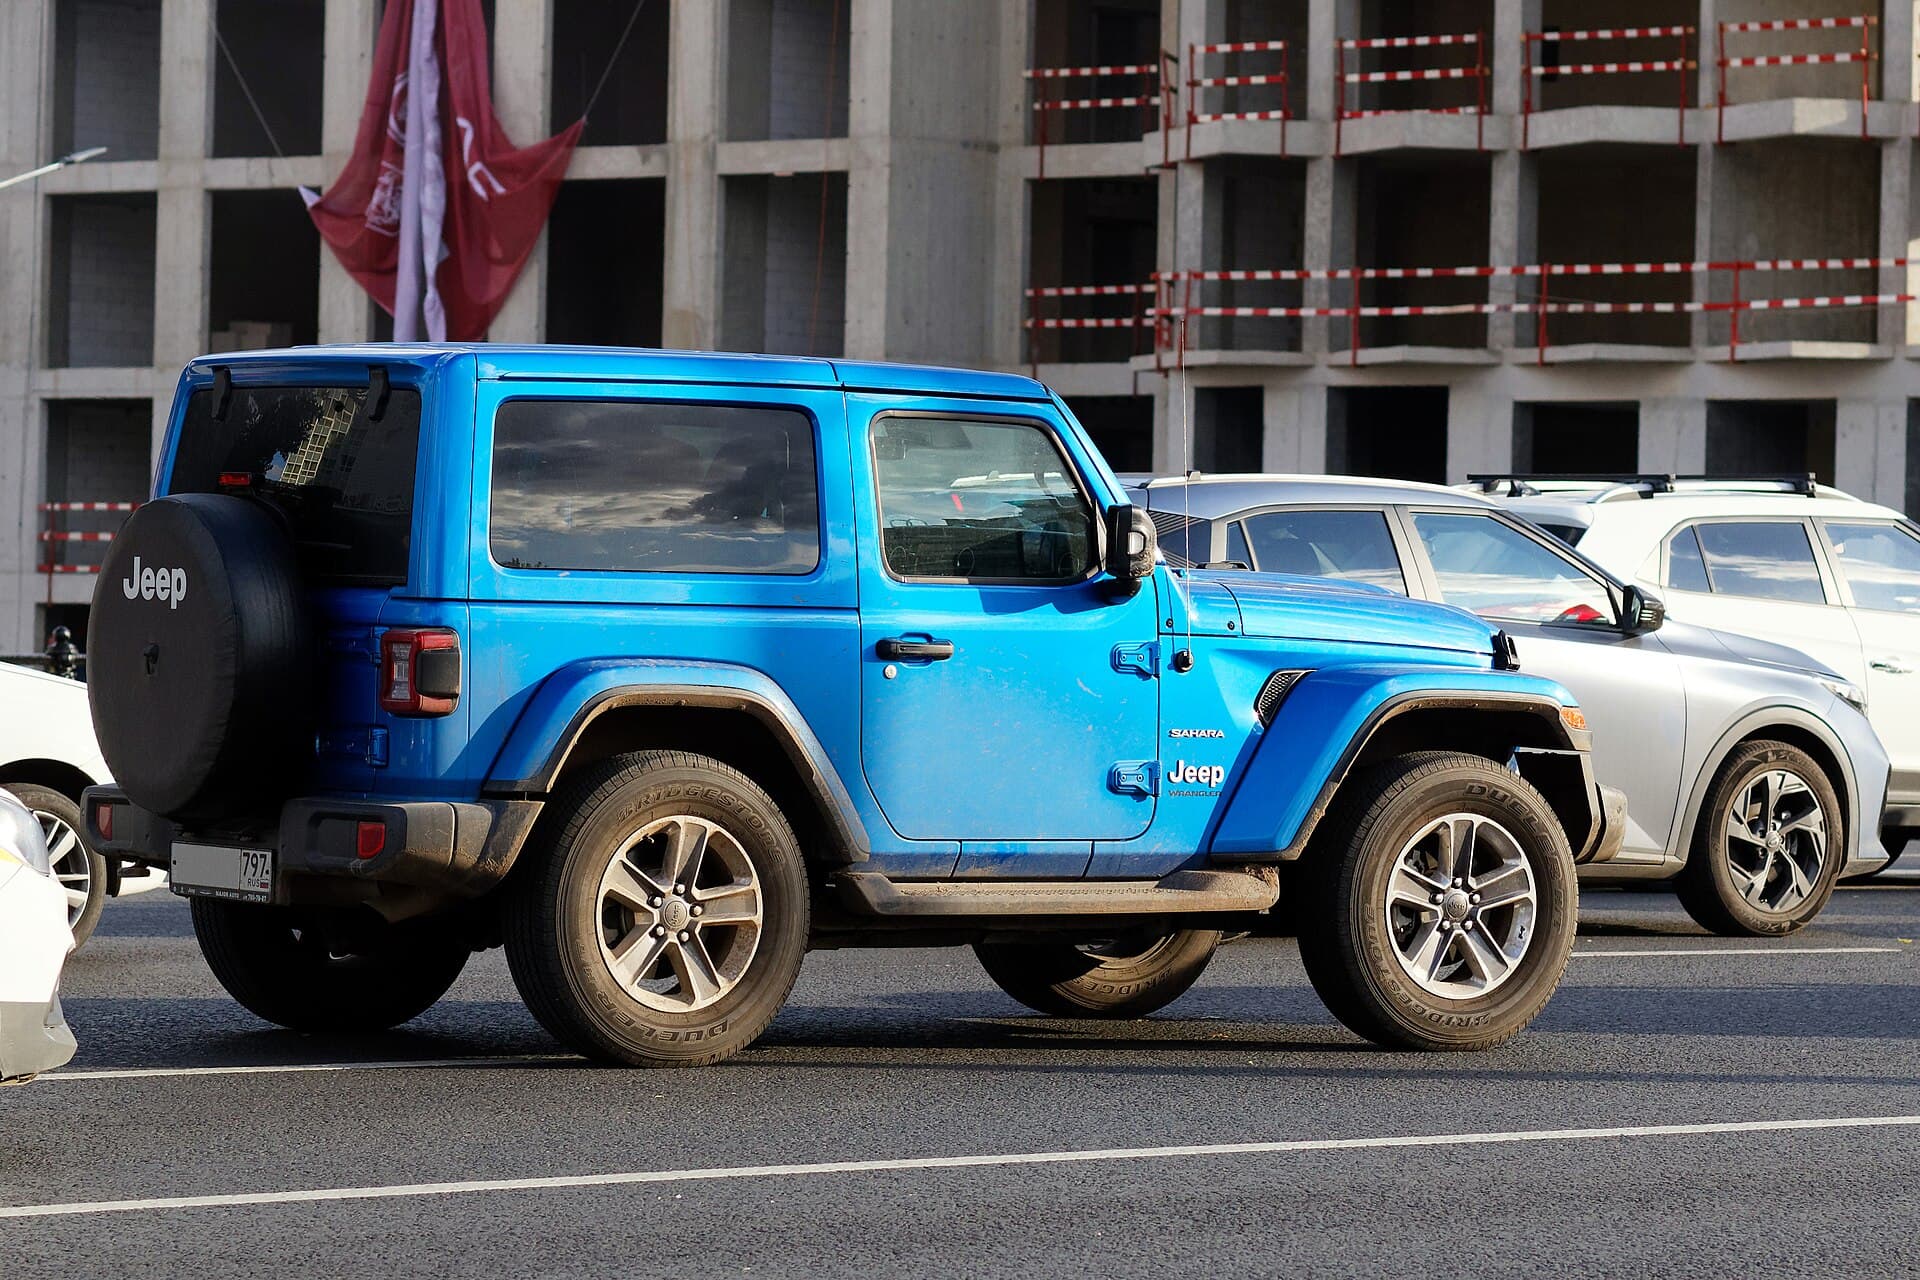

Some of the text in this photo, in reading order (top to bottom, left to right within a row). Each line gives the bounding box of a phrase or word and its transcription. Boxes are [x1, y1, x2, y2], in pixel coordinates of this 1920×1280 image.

[123, 556, 187, 610] Jeep
[1168, 728, 1225, 739] SAHARA
[1168, 759, 1225, 788] Jeep
[615, 782, 787, 866] BRIDGESTONE
[1463, 782, 1563, 881] DUELER
[243, 851, 267, 878] 797
[247, 878, 260, 888] RUS
[1363, 903, 1492, 1027] BRIDGESTONE
[596, 990, 729, 1042] DUELER
